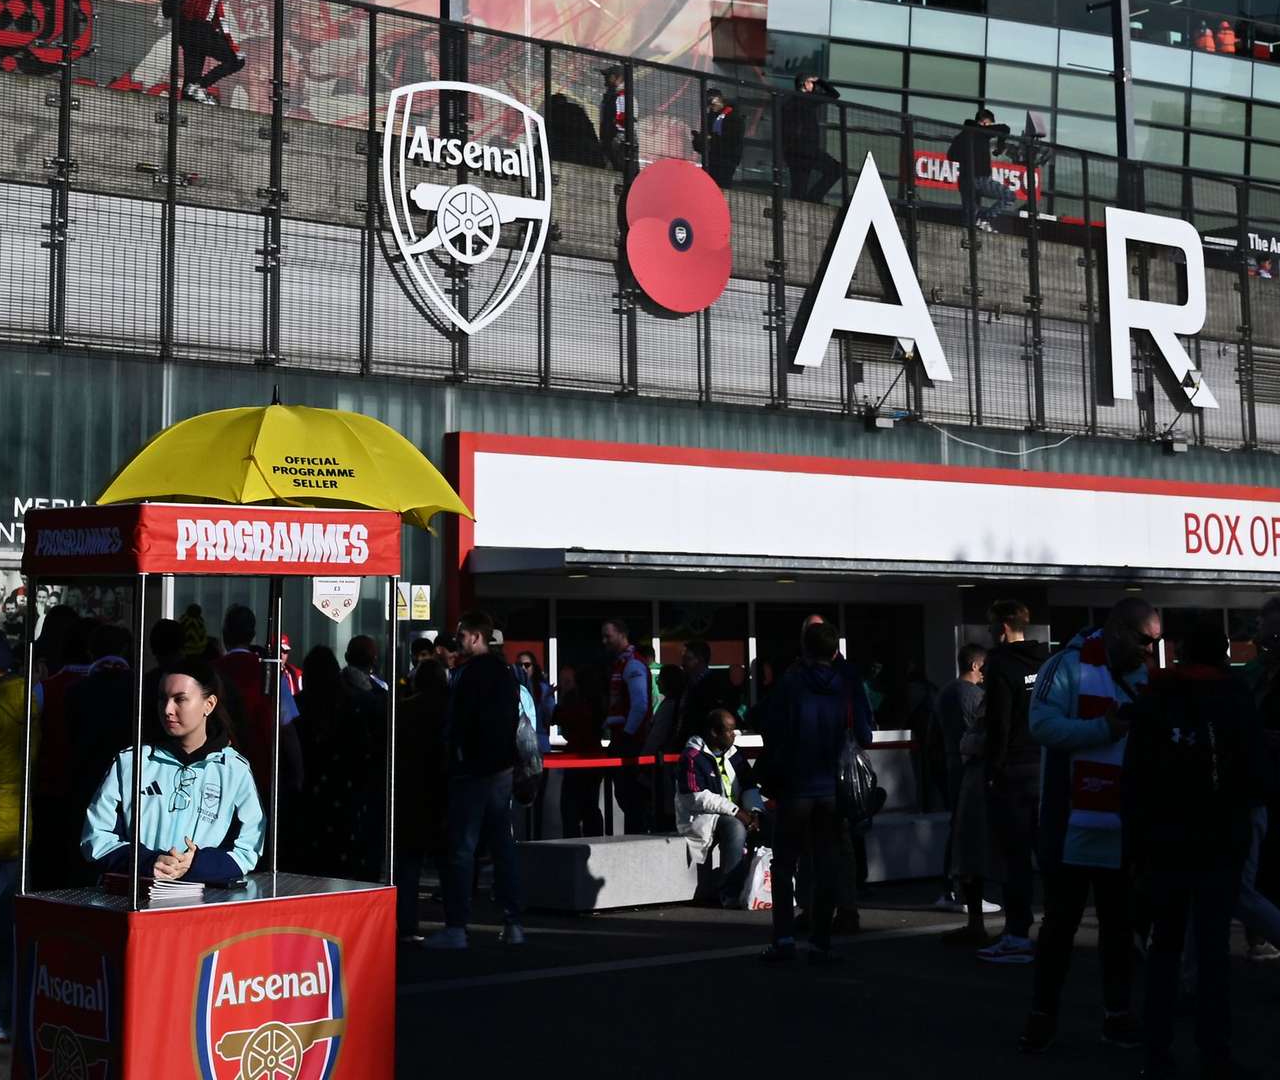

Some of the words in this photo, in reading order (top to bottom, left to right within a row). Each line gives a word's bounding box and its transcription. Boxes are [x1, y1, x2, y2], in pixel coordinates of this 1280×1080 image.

[408, 125, 529, 177] Arsenal
[1247, 233, 1269, 251] The
[272, 466, 355, 478] PROGRAMME
[285, 456, 339, 466] OFFICIAL
[293, 479, 338, 488] SELLER
[35, 527, 123, 556] PROGRAMMES
[176, 519, 369, 564] PROGRAMMES
[1184, 513, 1244, 555] BOX
[752, 898, 772, 910] Ice
[36, 964, 105, 1012] Arsenal
[214, 961, 327, 1008] Arsenal
